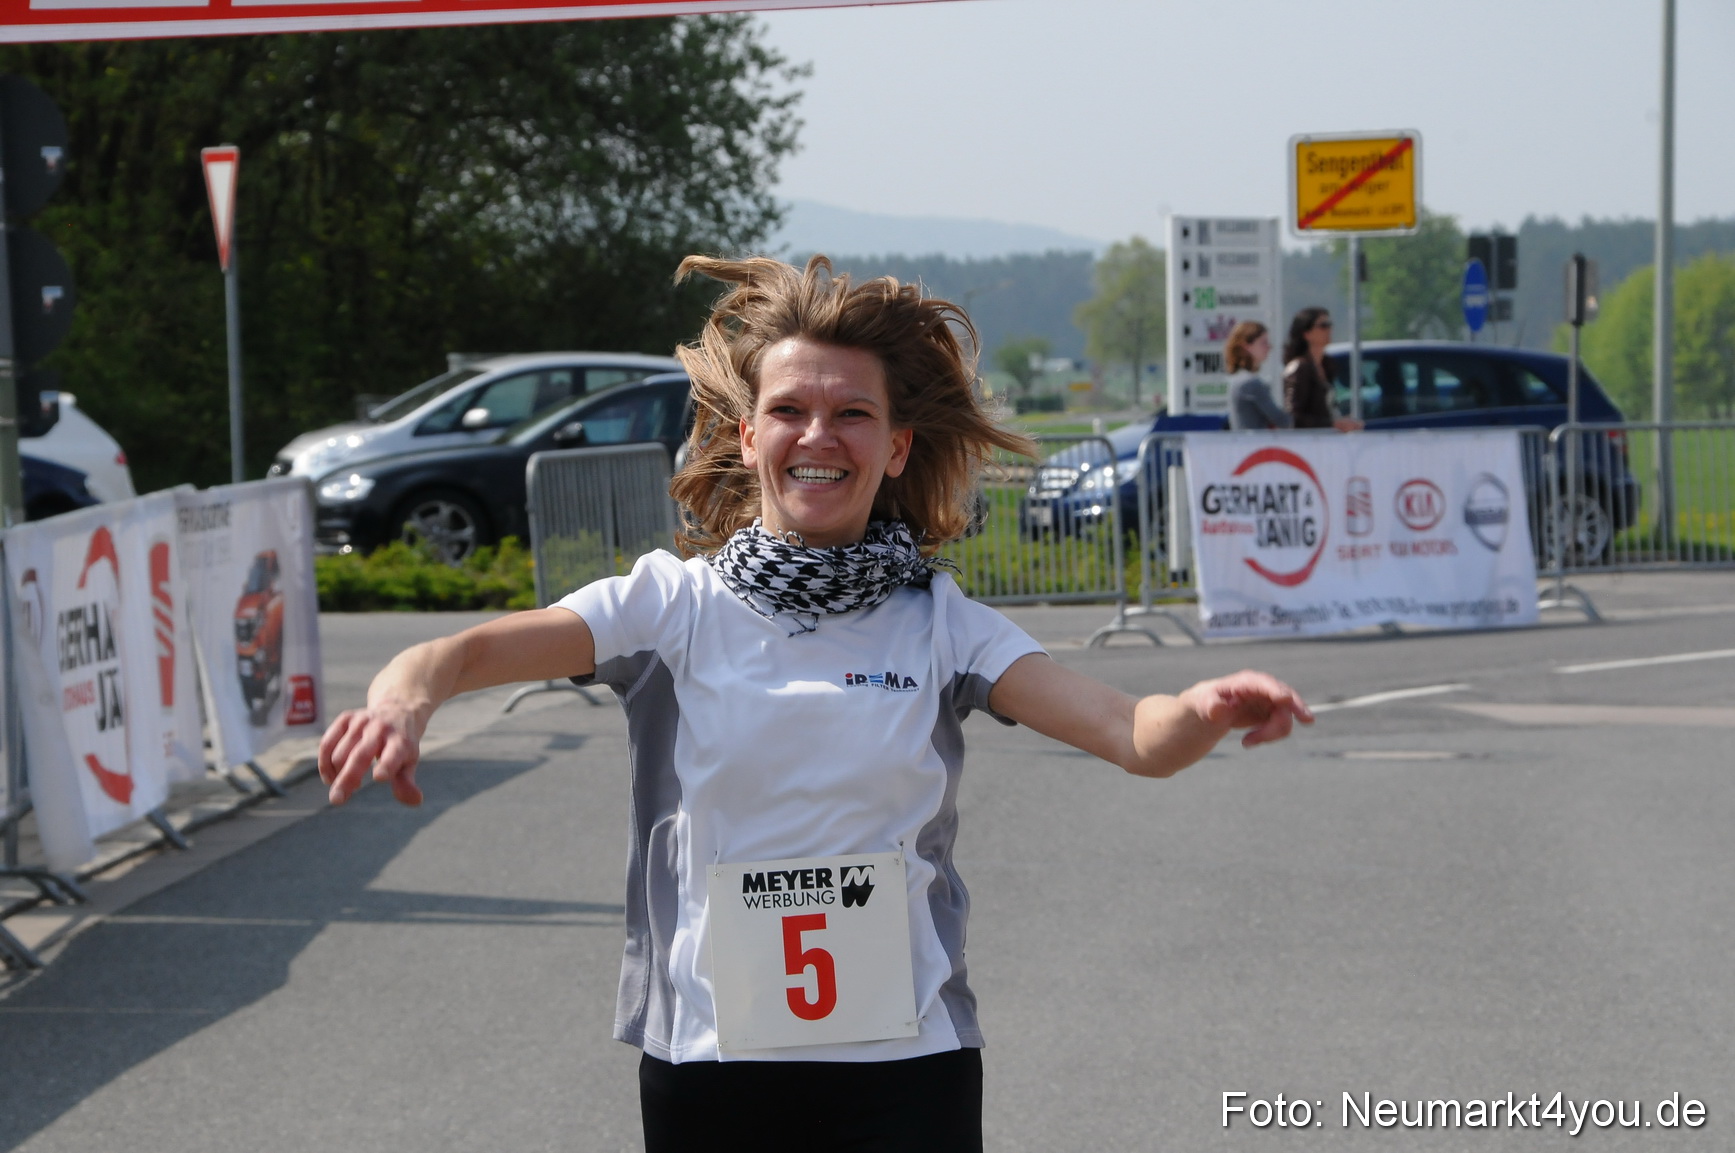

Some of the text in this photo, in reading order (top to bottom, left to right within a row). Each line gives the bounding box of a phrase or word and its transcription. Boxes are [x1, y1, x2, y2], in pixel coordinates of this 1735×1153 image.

[1202, 484, 1300, 515] GERHART
[1405, 492, 1437, 517] KIA
[743, 868, 834, 894] MEYER
[743, 890, 836, 910] WERBUNG
[782, 913, 837, 1021] 5
